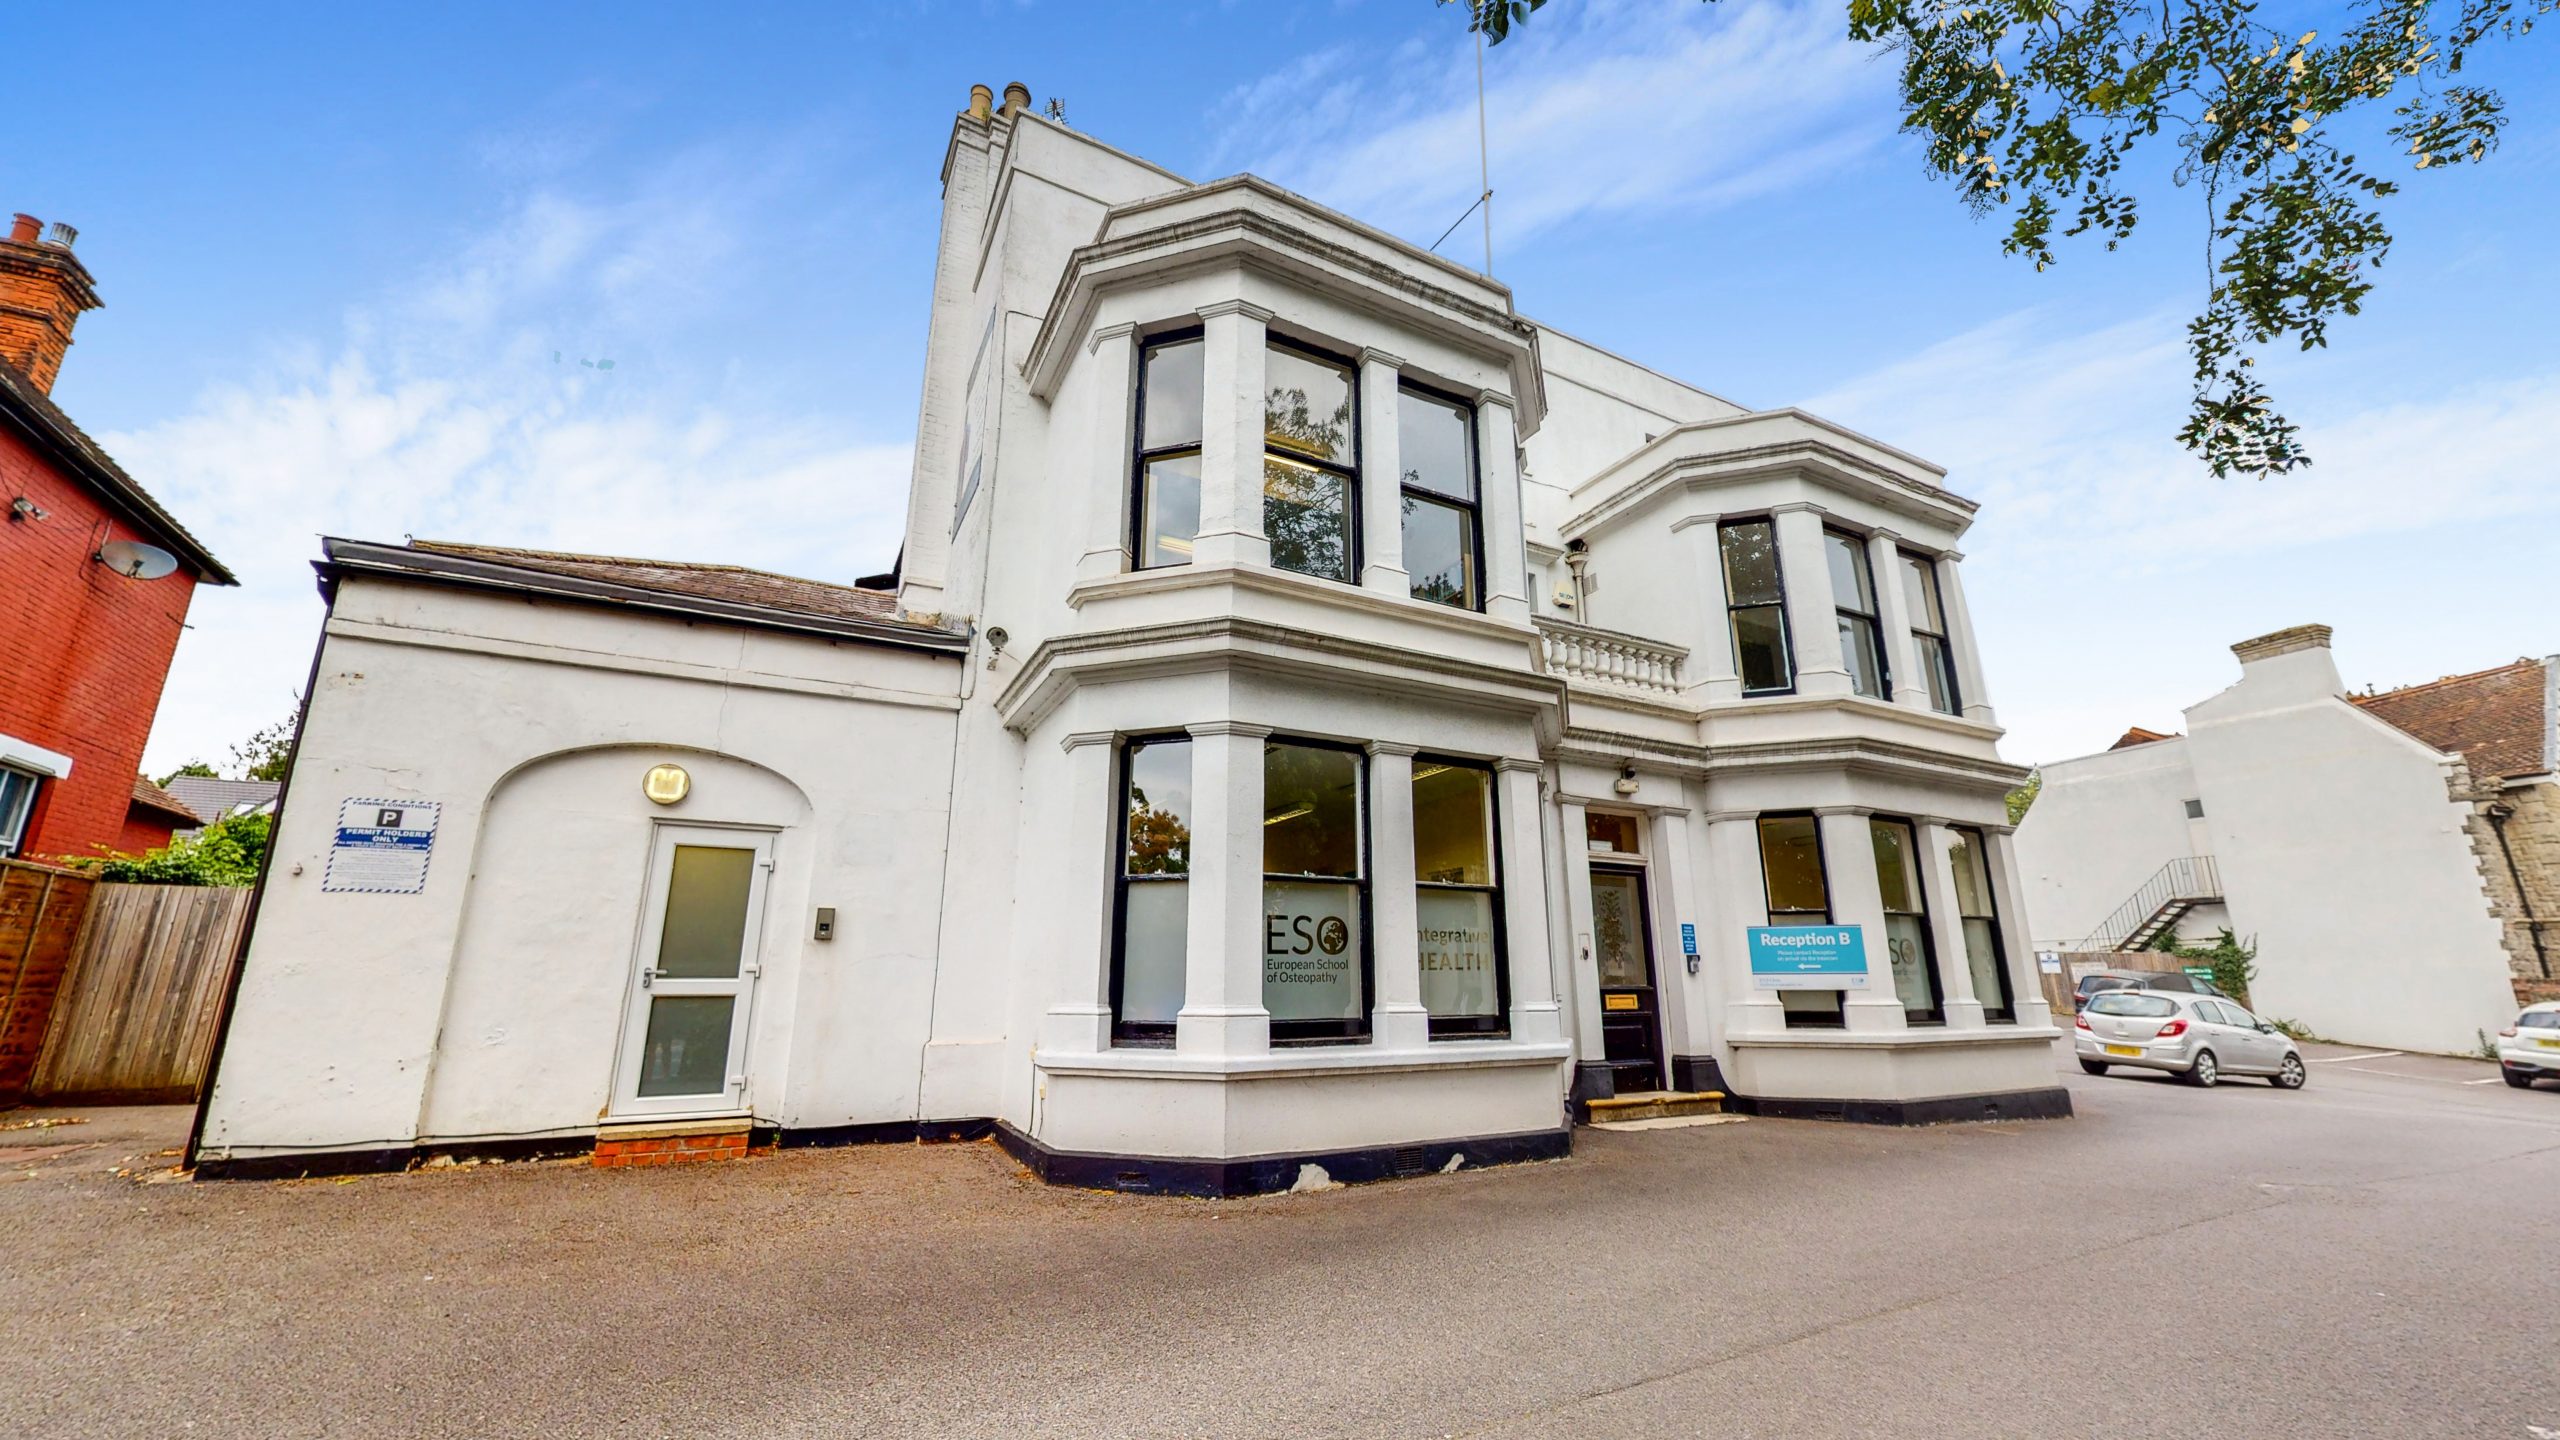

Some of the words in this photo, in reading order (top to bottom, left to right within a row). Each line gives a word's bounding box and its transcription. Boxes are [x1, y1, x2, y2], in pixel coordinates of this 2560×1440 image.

[387, 802, 432, 810] CONDITIONS
[382, 811, 397, 825] P
[346, 828, 382, 836] PERMIT
[383, 830, 428, 838] HOLDERS
[372, 835, 399, 843] ONLY
[1267, 915, 1349, 955] ESO
[1417, 927, 1489, 945] ntegrative
[1760, 932, 1836, 948] Reception
[1839, 932, 1851, 945] B
[1888, 938, 1916, 965] SO
[1267, 959, 1315, 971] European
[1317, 959, 1349, 970] School
[1267, 971, 1278, 983] of
[1279, 971, 1338, 984] Osteopathy
